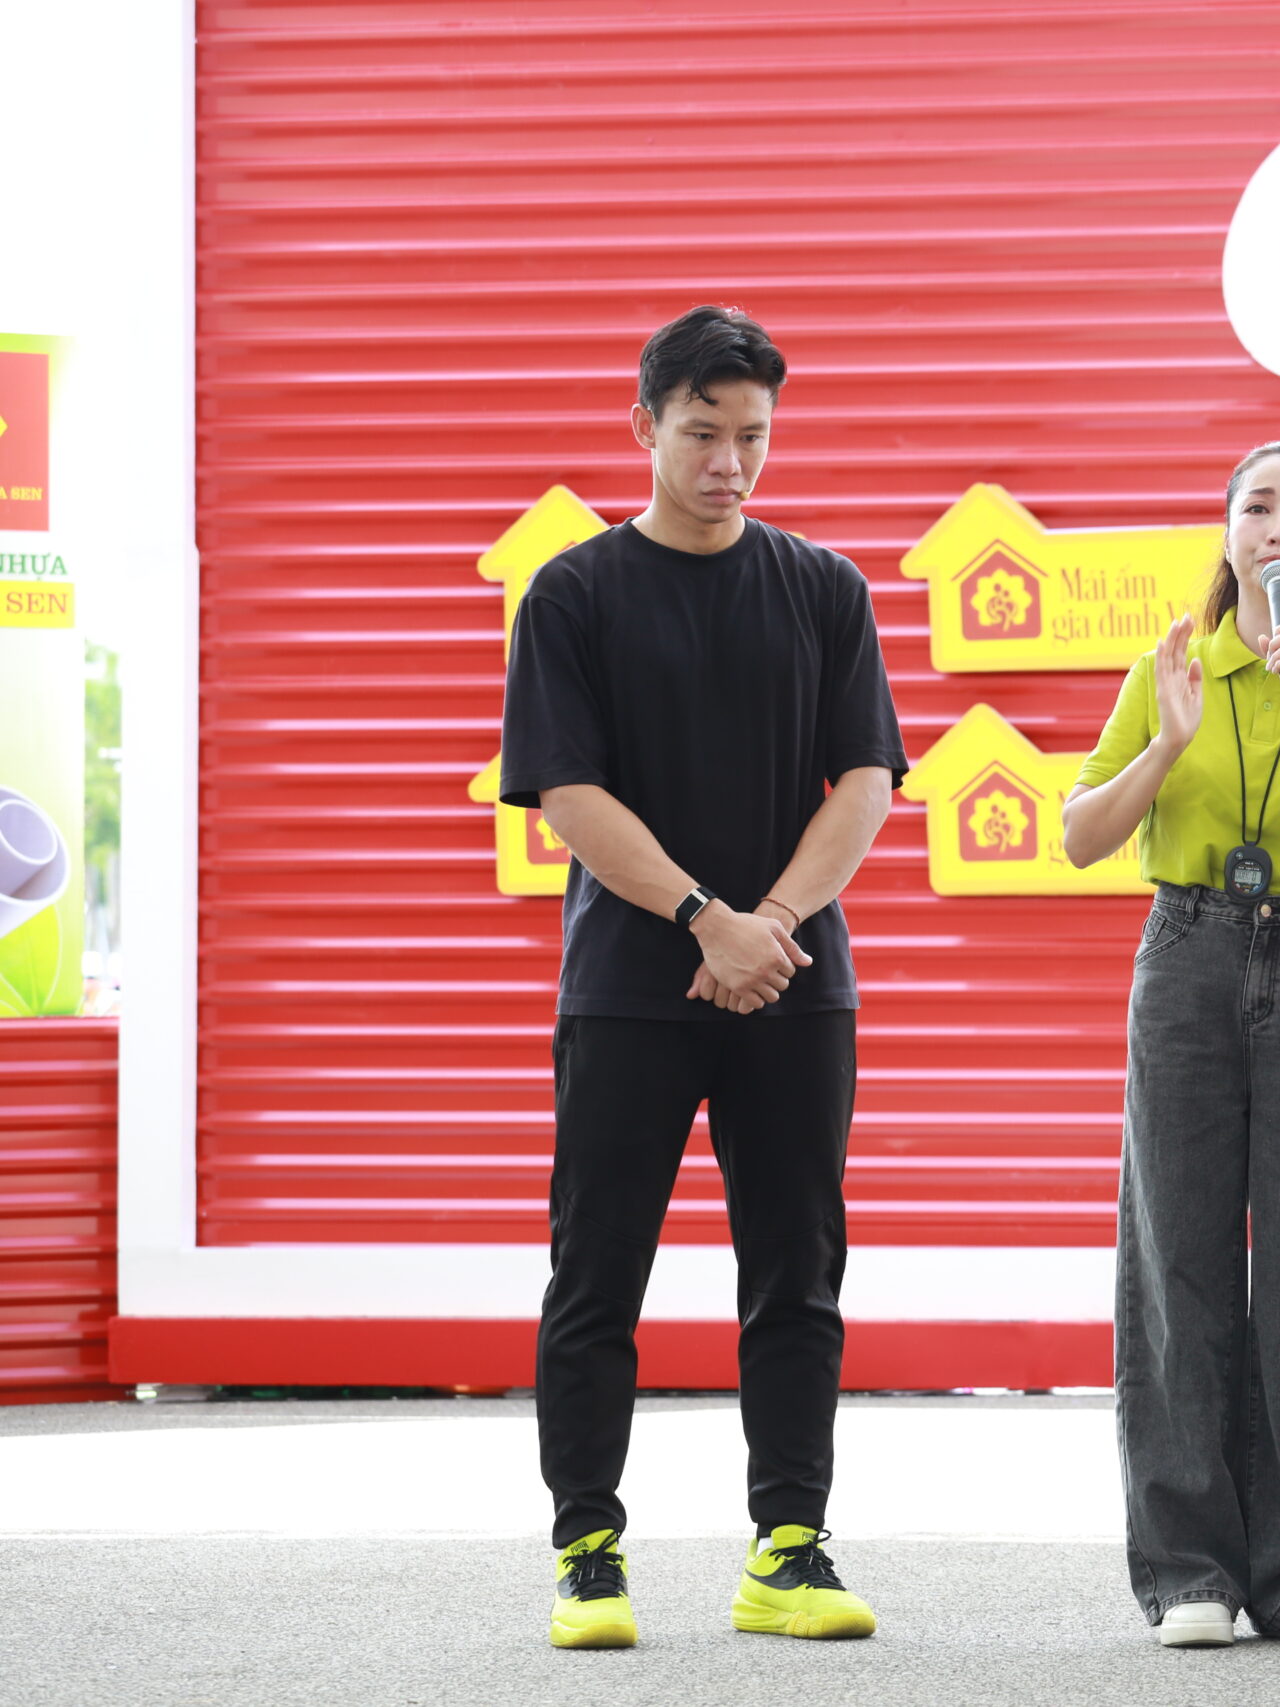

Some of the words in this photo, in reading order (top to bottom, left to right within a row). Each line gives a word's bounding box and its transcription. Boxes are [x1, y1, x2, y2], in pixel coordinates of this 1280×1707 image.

[10, 487, 43, 500] SEN
[1060, 567, 1107, 602] Mái
[6, 591, 68, 614] SEN
[1051, 608, 1090, 648] gia
